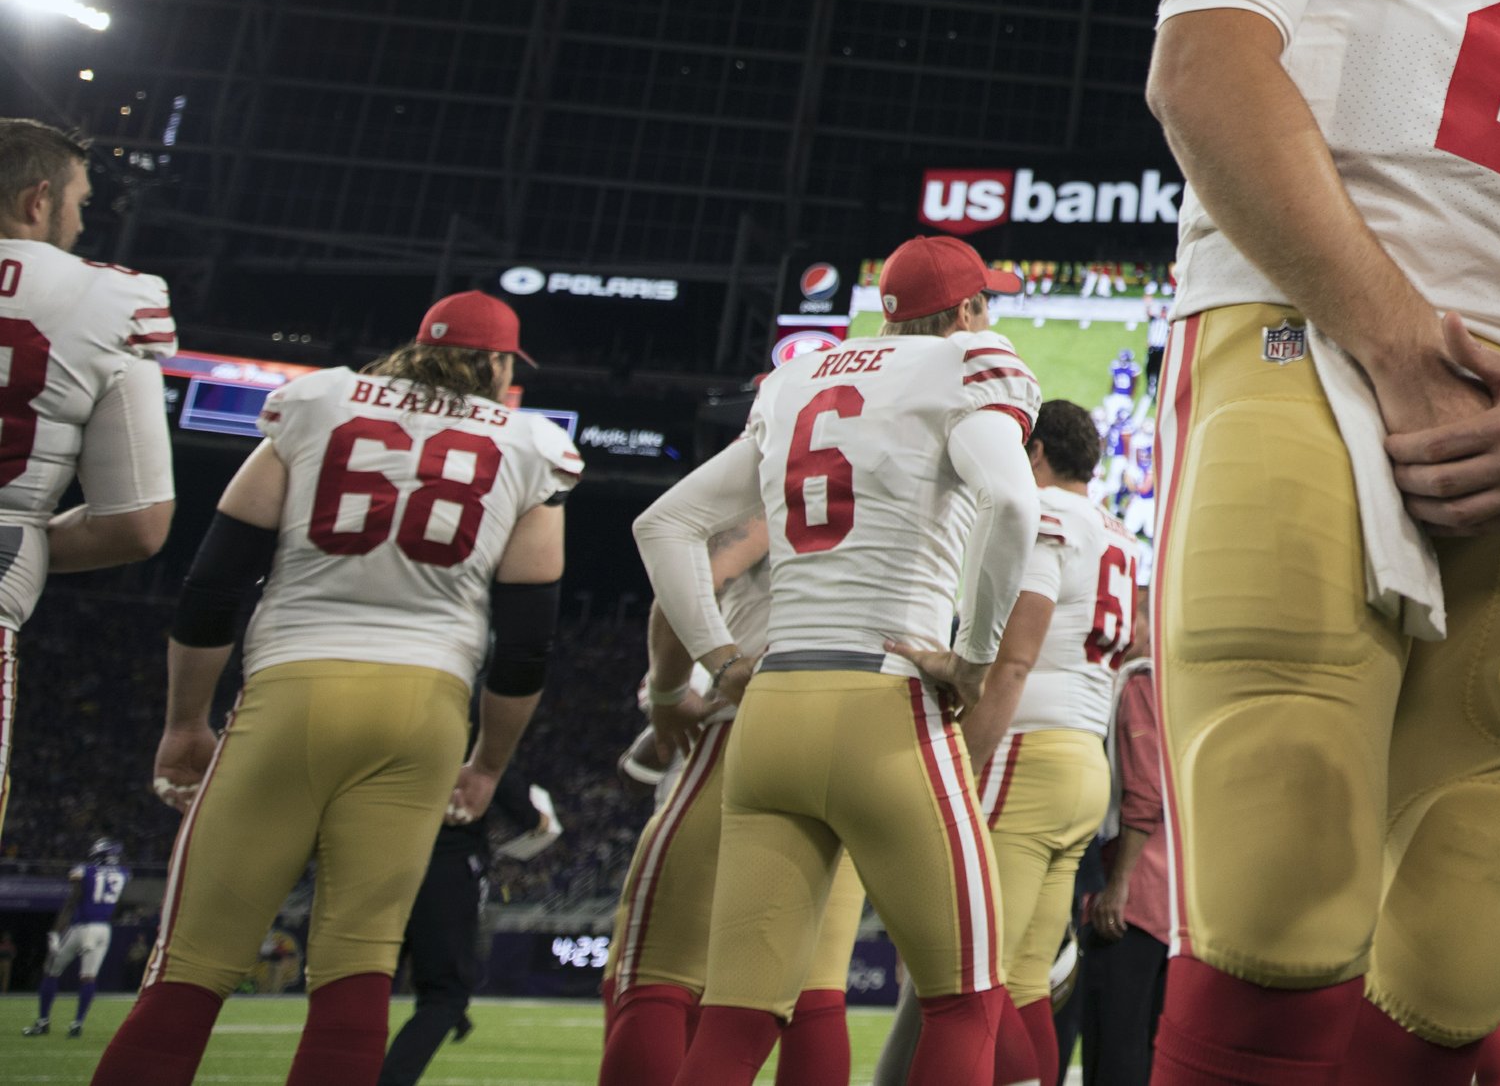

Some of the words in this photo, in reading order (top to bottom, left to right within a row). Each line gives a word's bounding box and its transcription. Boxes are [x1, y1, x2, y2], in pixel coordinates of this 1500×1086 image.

[547, 272, 679, 301] POLARIS
[811, 347, 896, 380] ROSE
[1269, 340, 1301, 358] NFL
[350, 380, 511, 427] BEADLES
[784, 385, 865, 554] 6
[308, 416, 504, 569] 68
